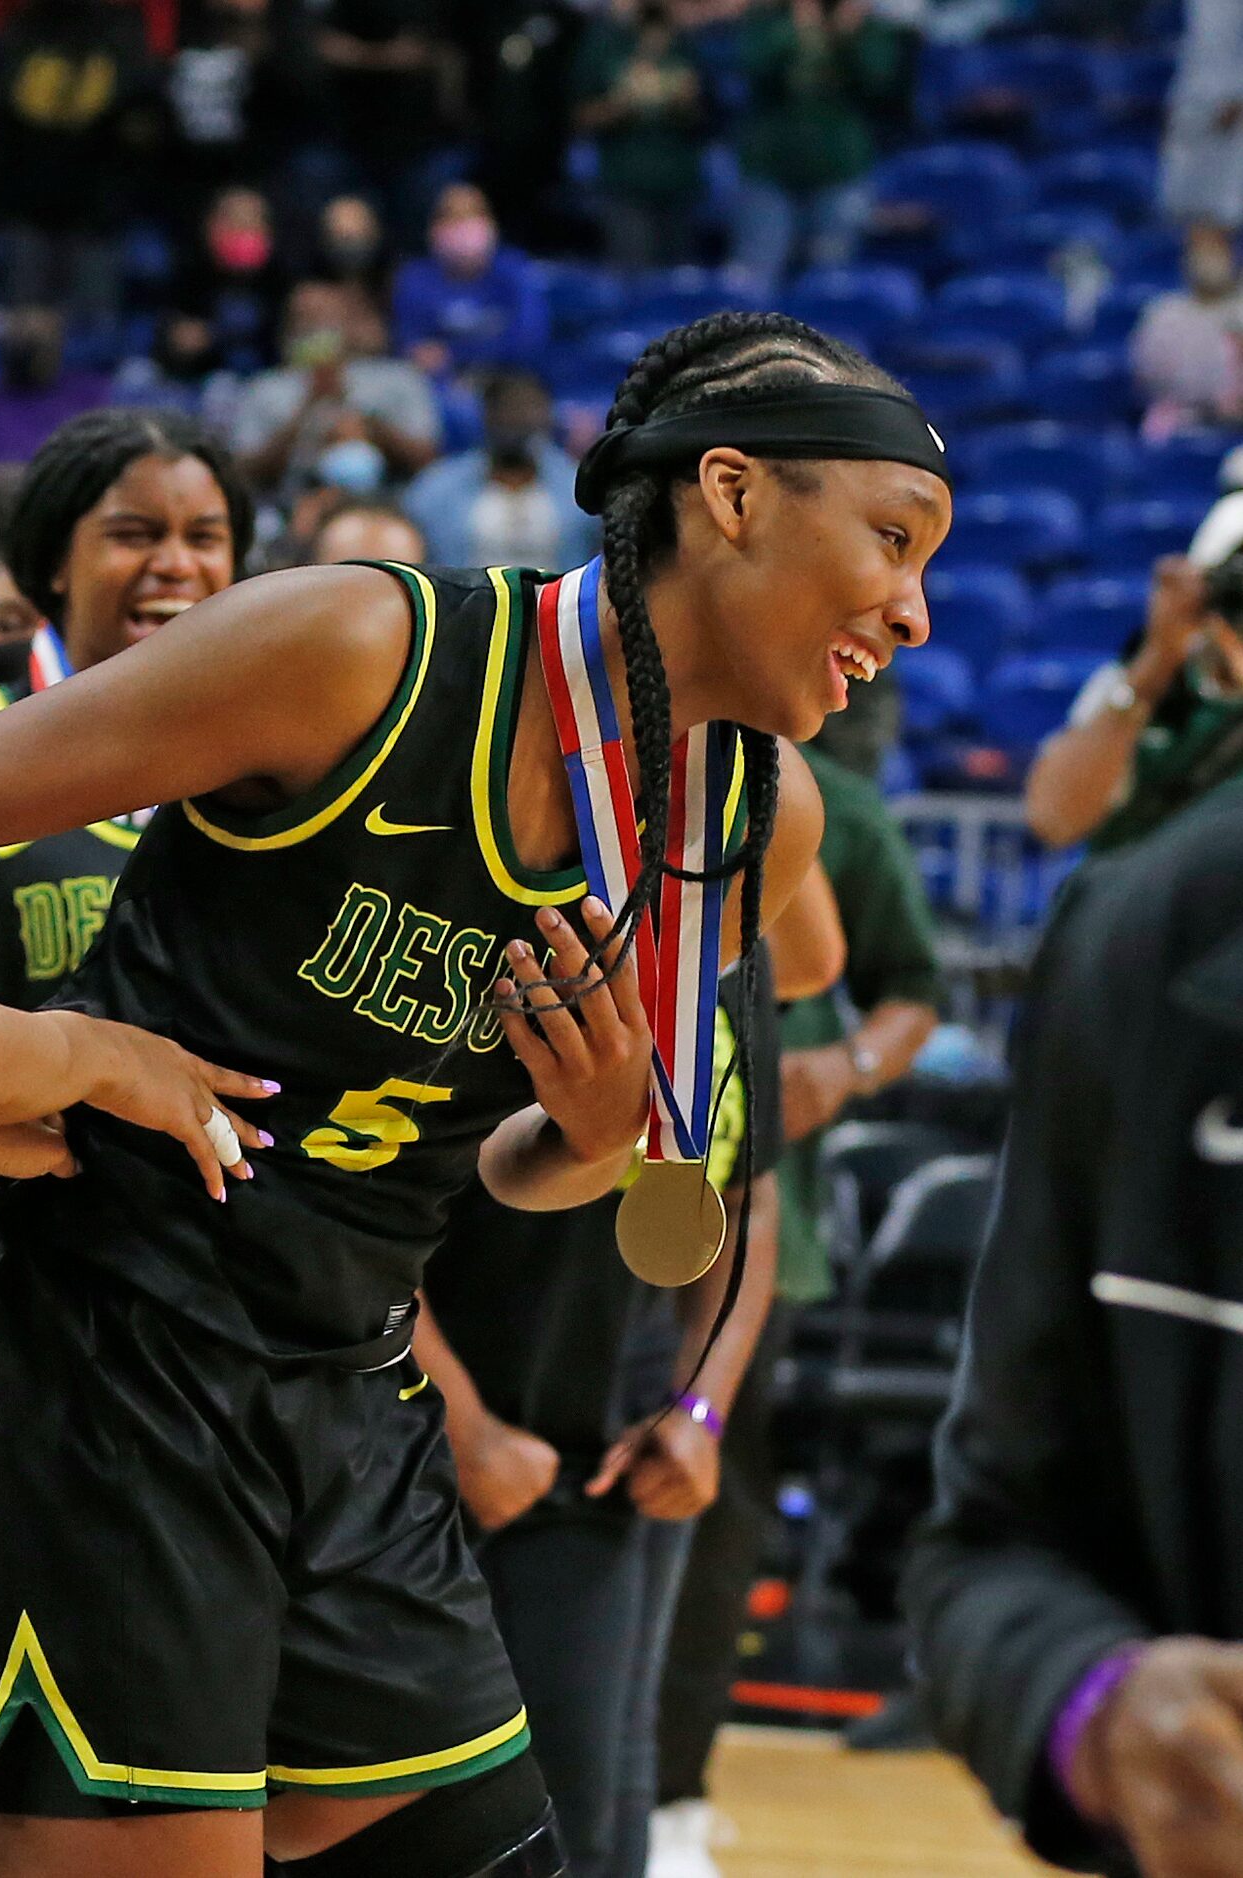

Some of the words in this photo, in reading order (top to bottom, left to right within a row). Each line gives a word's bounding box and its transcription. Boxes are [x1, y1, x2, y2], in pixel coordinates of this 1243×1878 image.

[13, 875, 121, 981] DE
[297, 882, 557, 1054] DESO
[300, 1077, 453, 1172] 5
